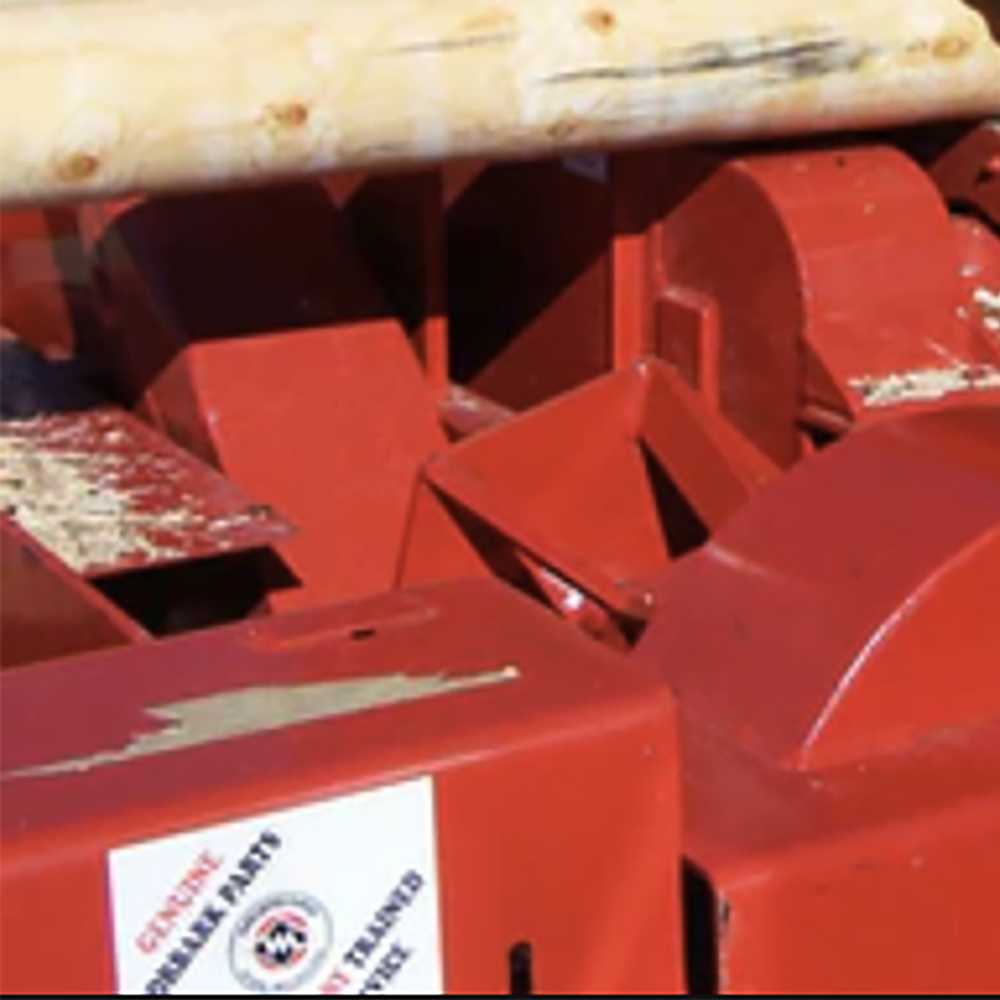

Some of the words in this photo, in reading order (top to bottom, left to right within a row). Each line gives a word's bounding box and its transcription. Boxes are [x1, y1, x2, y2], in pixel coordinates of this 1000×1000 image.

[135, 849, 224, 954] GENUINE
[145, 902, 227, 994] ORBARK
[218, 828, 283, 905] PARTS
[343, 868, 425, 968] TRAINED
[358, 941, 416, 994] VICE
